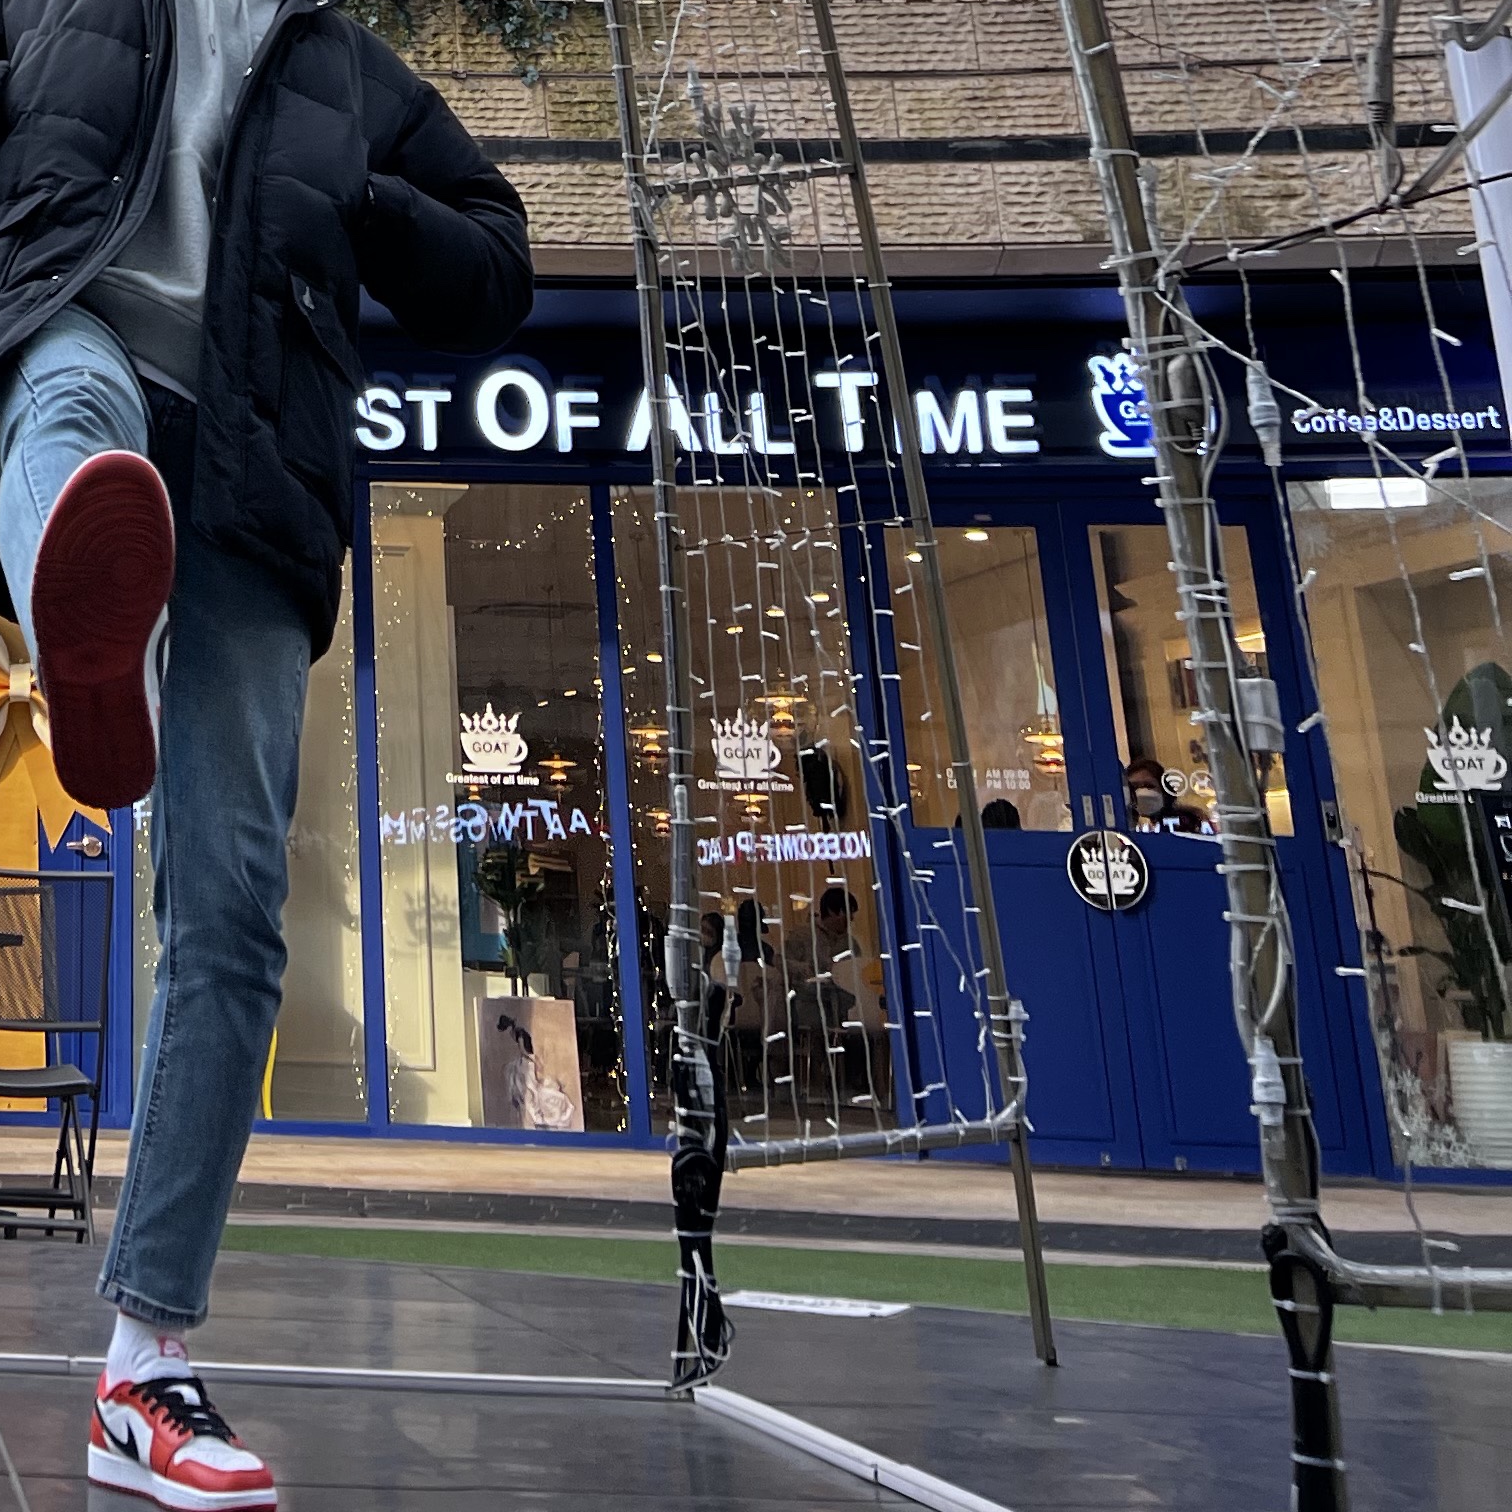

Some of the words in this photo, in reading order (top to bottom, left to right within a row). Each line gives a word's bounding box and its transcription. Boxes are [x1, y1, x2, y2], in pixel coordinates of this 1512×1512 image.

[476, 368, 601, 452] OF
[626, 373, 796, 456] ALL
[814, 371, 1041, 454] TME
[1292, 405, 1503, 434] Coffee&Dessert
[472, 740, 510, 754] GOAT
[724, 746, 763, 760] GOAT
[1441, 756, 1486, 771] GOAT
[445, 772, 489, 784] Greatest
[490, 774, 501, 785] of
[503, 774, 515, 785] all
[517, 775, 540, 786] time
[1088, 870, 1126, 880] GOAT
